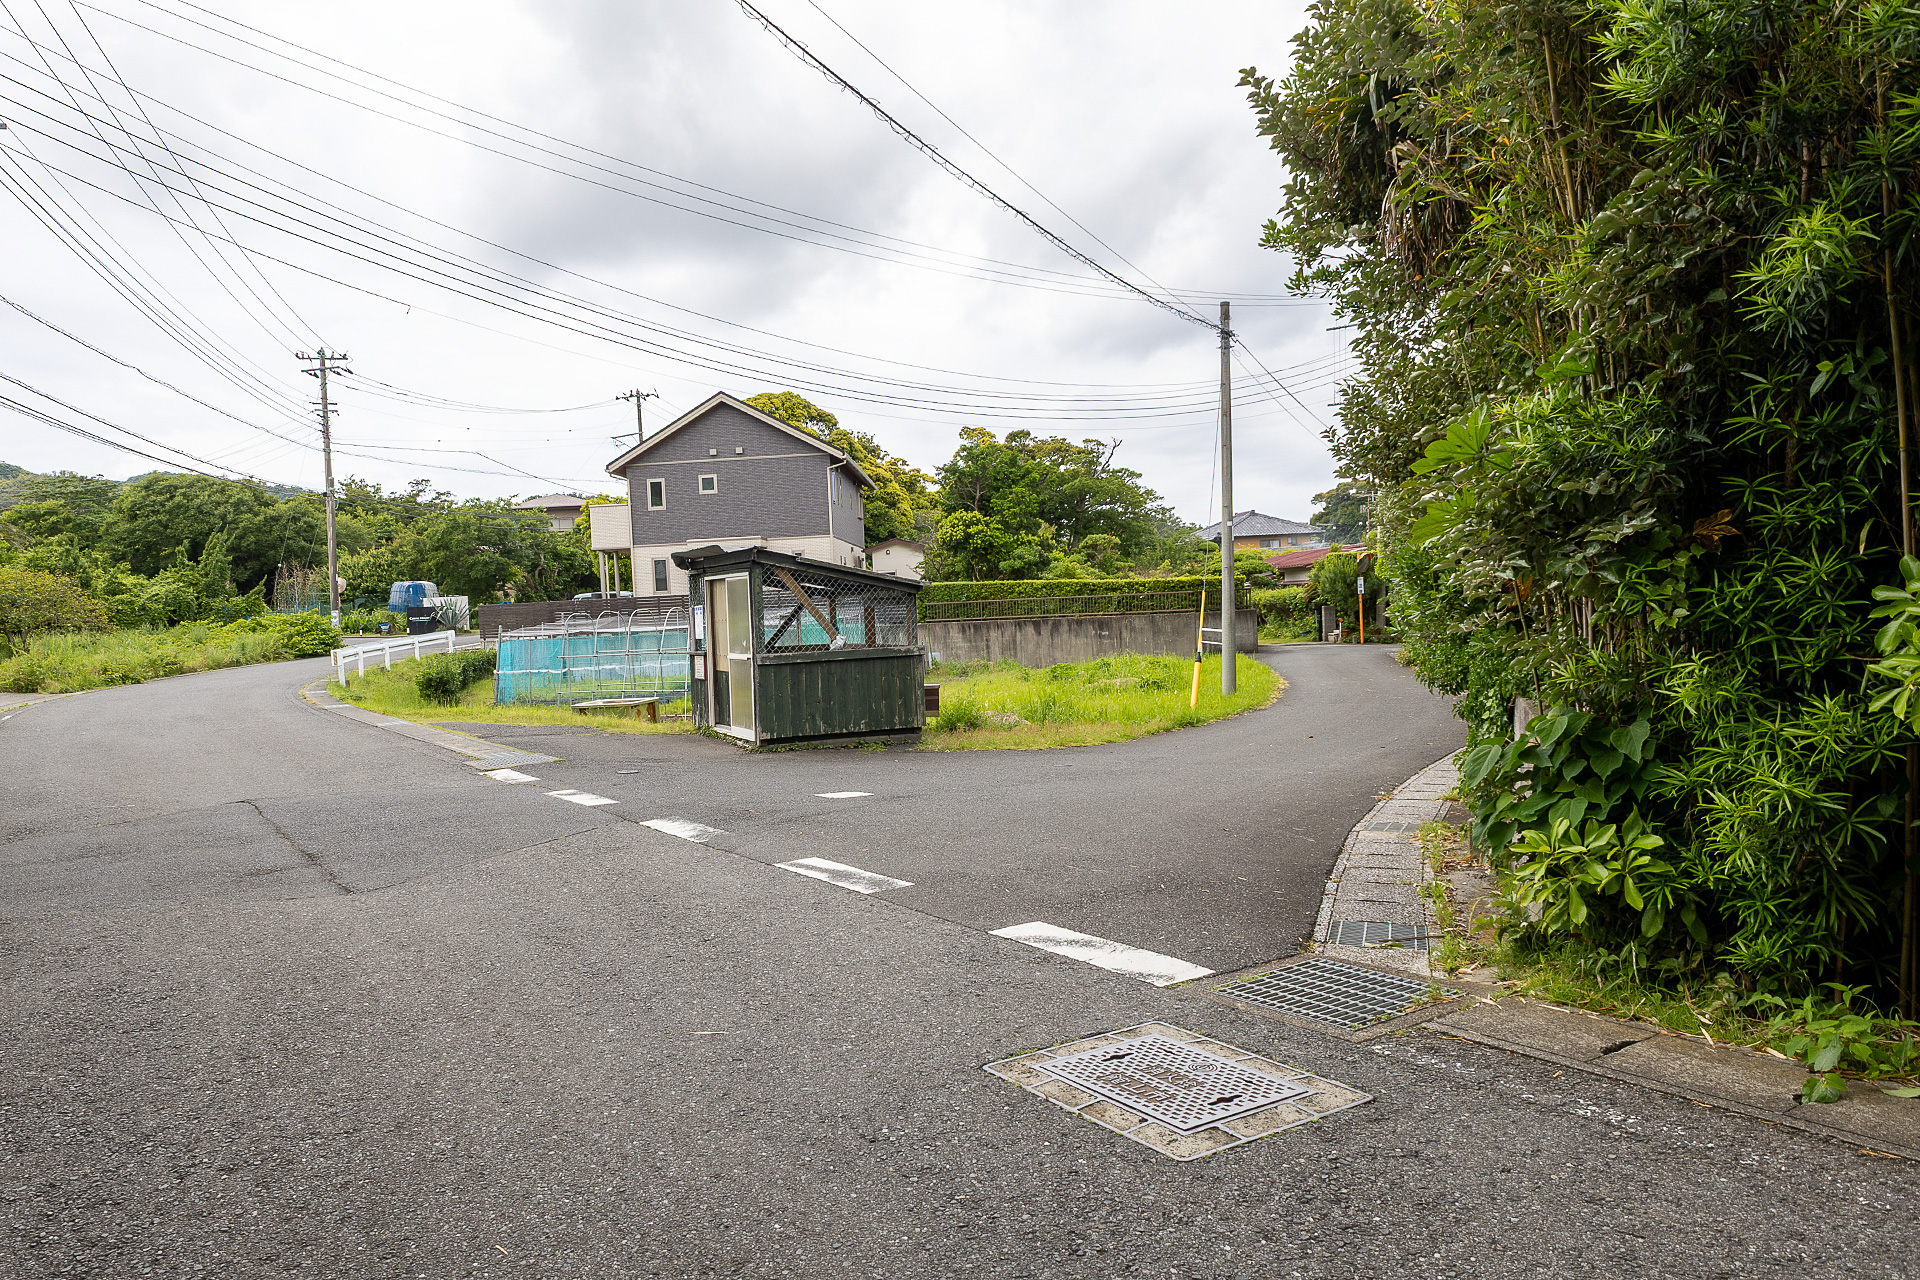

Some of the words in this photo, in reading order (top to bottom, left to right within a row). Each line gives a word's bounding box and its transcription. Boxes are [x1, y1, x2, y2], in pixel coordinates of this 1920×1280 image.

[1099, 1073, 1172, 1101] 館山市
[1139, 1065, 1199, 1089] 消火栓
